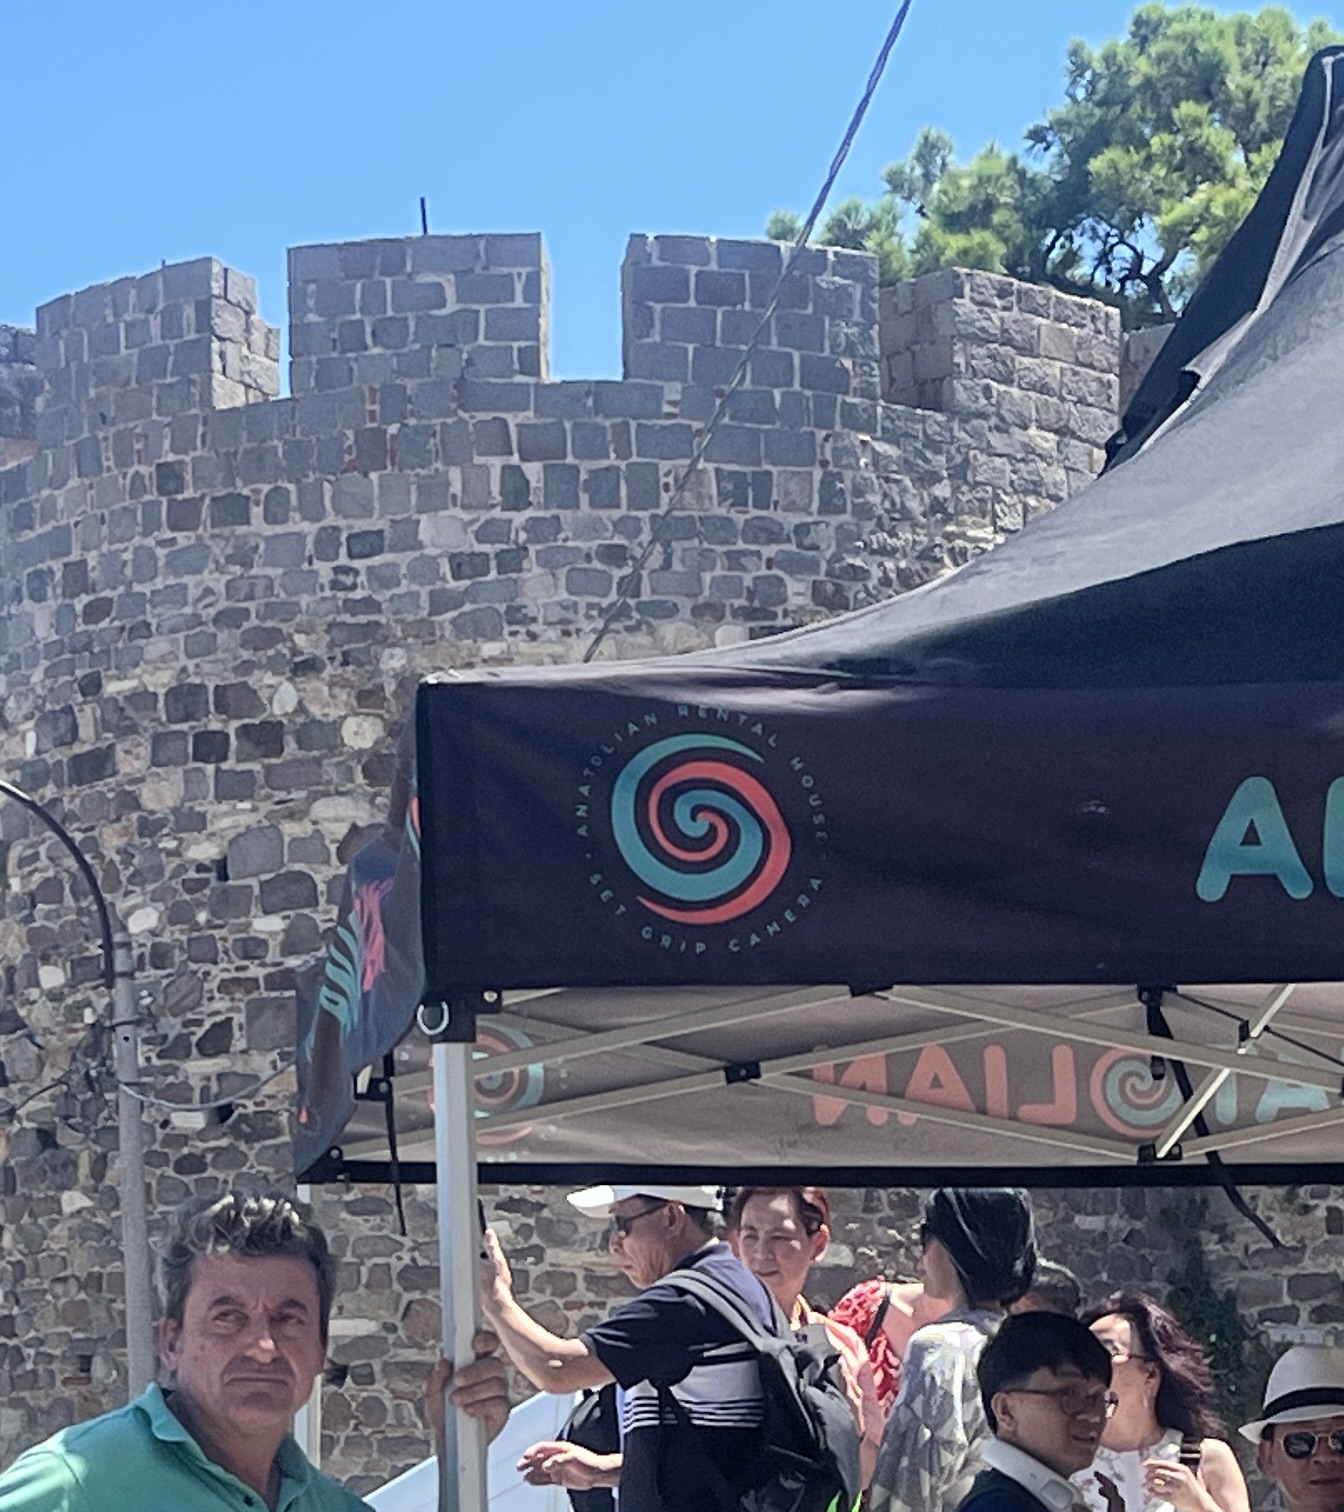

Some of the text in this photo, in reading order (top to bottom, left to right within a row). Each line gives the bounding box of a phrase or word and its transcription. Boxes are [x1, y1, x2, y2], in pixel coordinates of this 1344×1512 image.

[576, 705, 829, 843] ANATOLIAN RENTAL HOUSE
[590, 873, 822, 954] SET GRIP CAMERA
